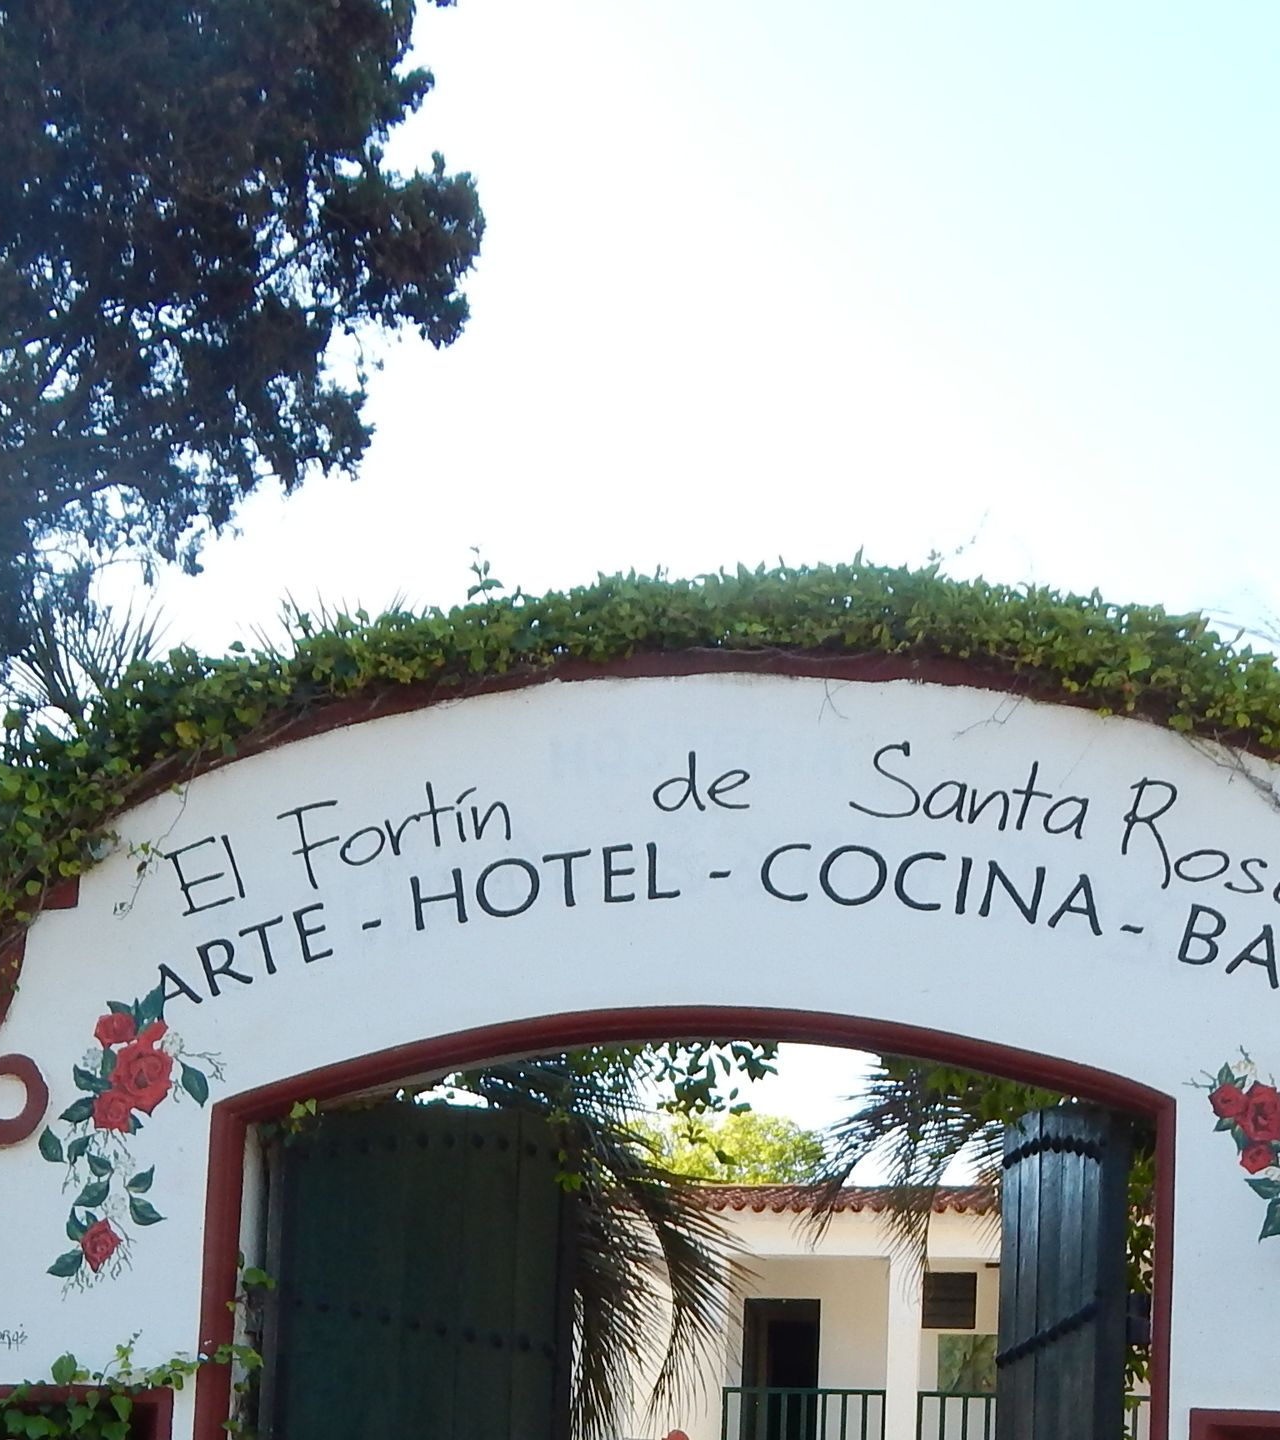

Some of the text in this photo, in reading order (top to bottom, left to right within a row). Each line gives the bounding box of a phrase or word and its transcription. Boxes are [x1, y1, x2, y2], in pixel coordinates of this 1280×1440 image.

[164, 835, 246, 916] El
[277, 781, 512, 889] Fortín
[652, 751, 752, 812] de
[849, 741, 1090, 839] Santa
[157, 902, 334, 1021] ARTE
[410, 842, 681, 931] HOTEL
[761, 843, 1103, 936] COCINA
